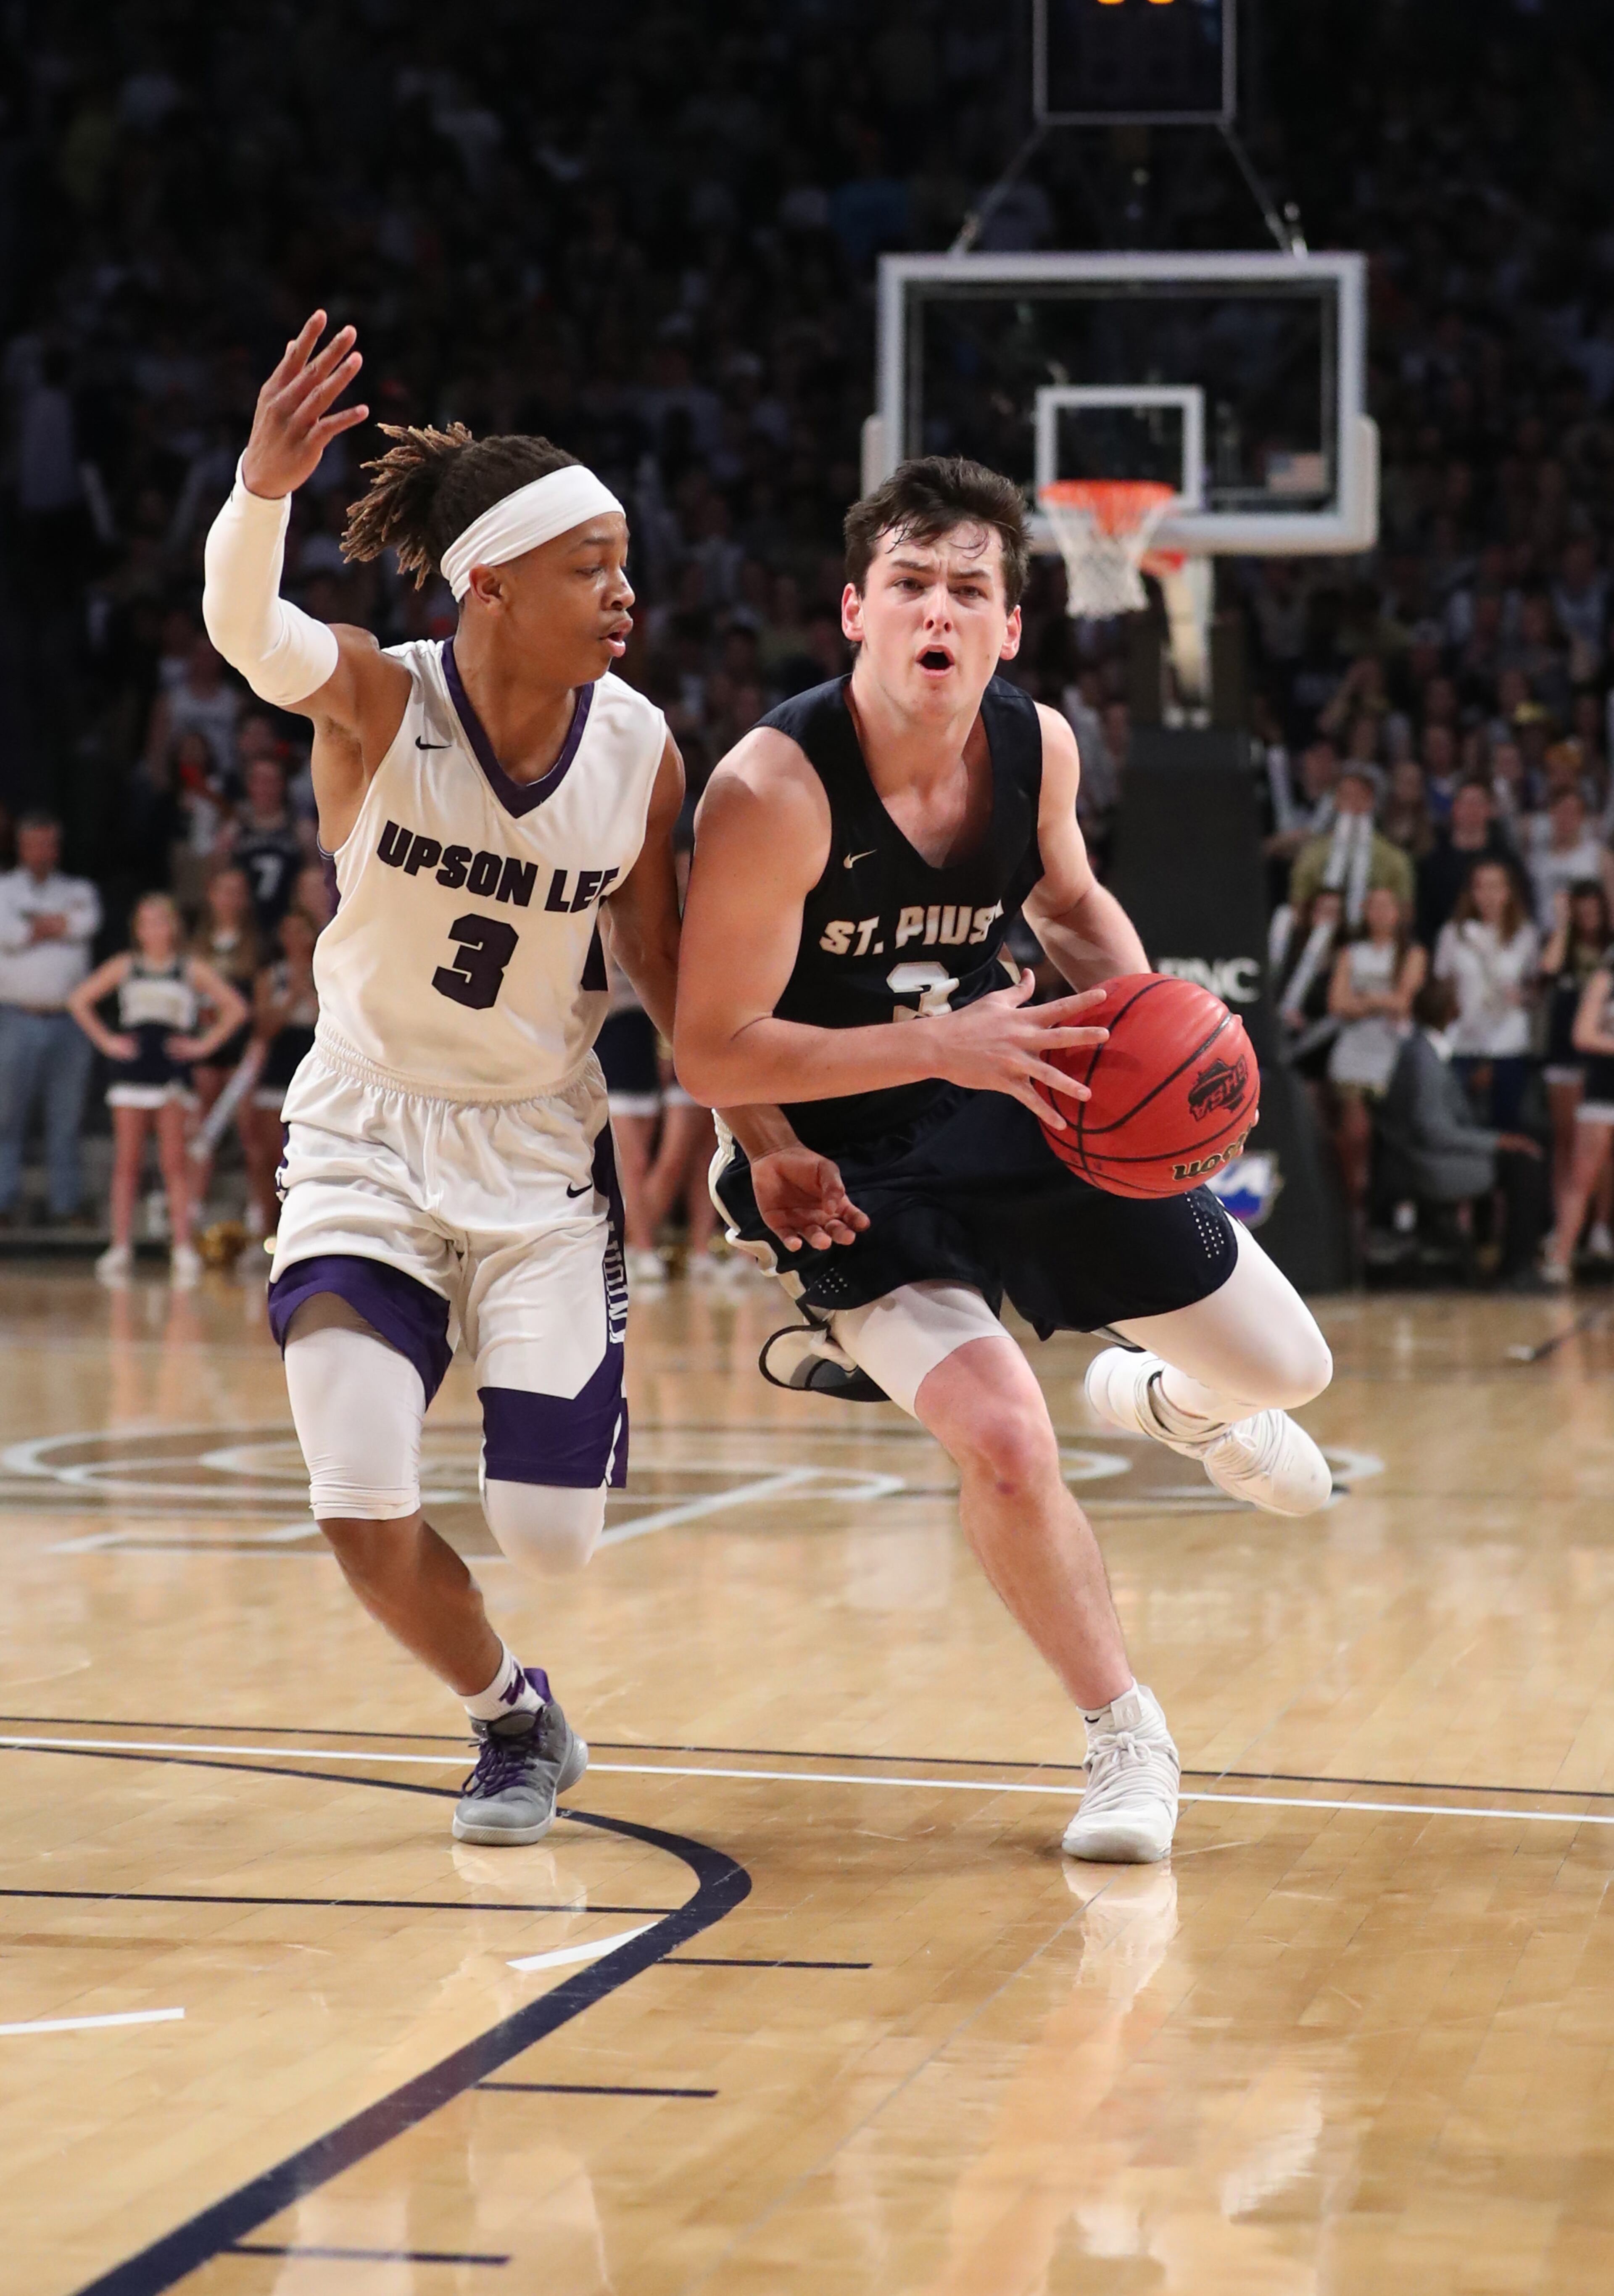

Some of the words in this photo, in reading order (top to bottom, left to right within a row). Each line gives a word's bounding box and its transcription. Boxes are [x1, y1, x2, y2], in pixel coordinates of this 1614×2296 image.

[377, 820, 539, 907] UPSON
[432, 913, 519, 1010] 3
[819, 916, 883, 956] ST.
[895, 899, 1004, 949] PIUS
